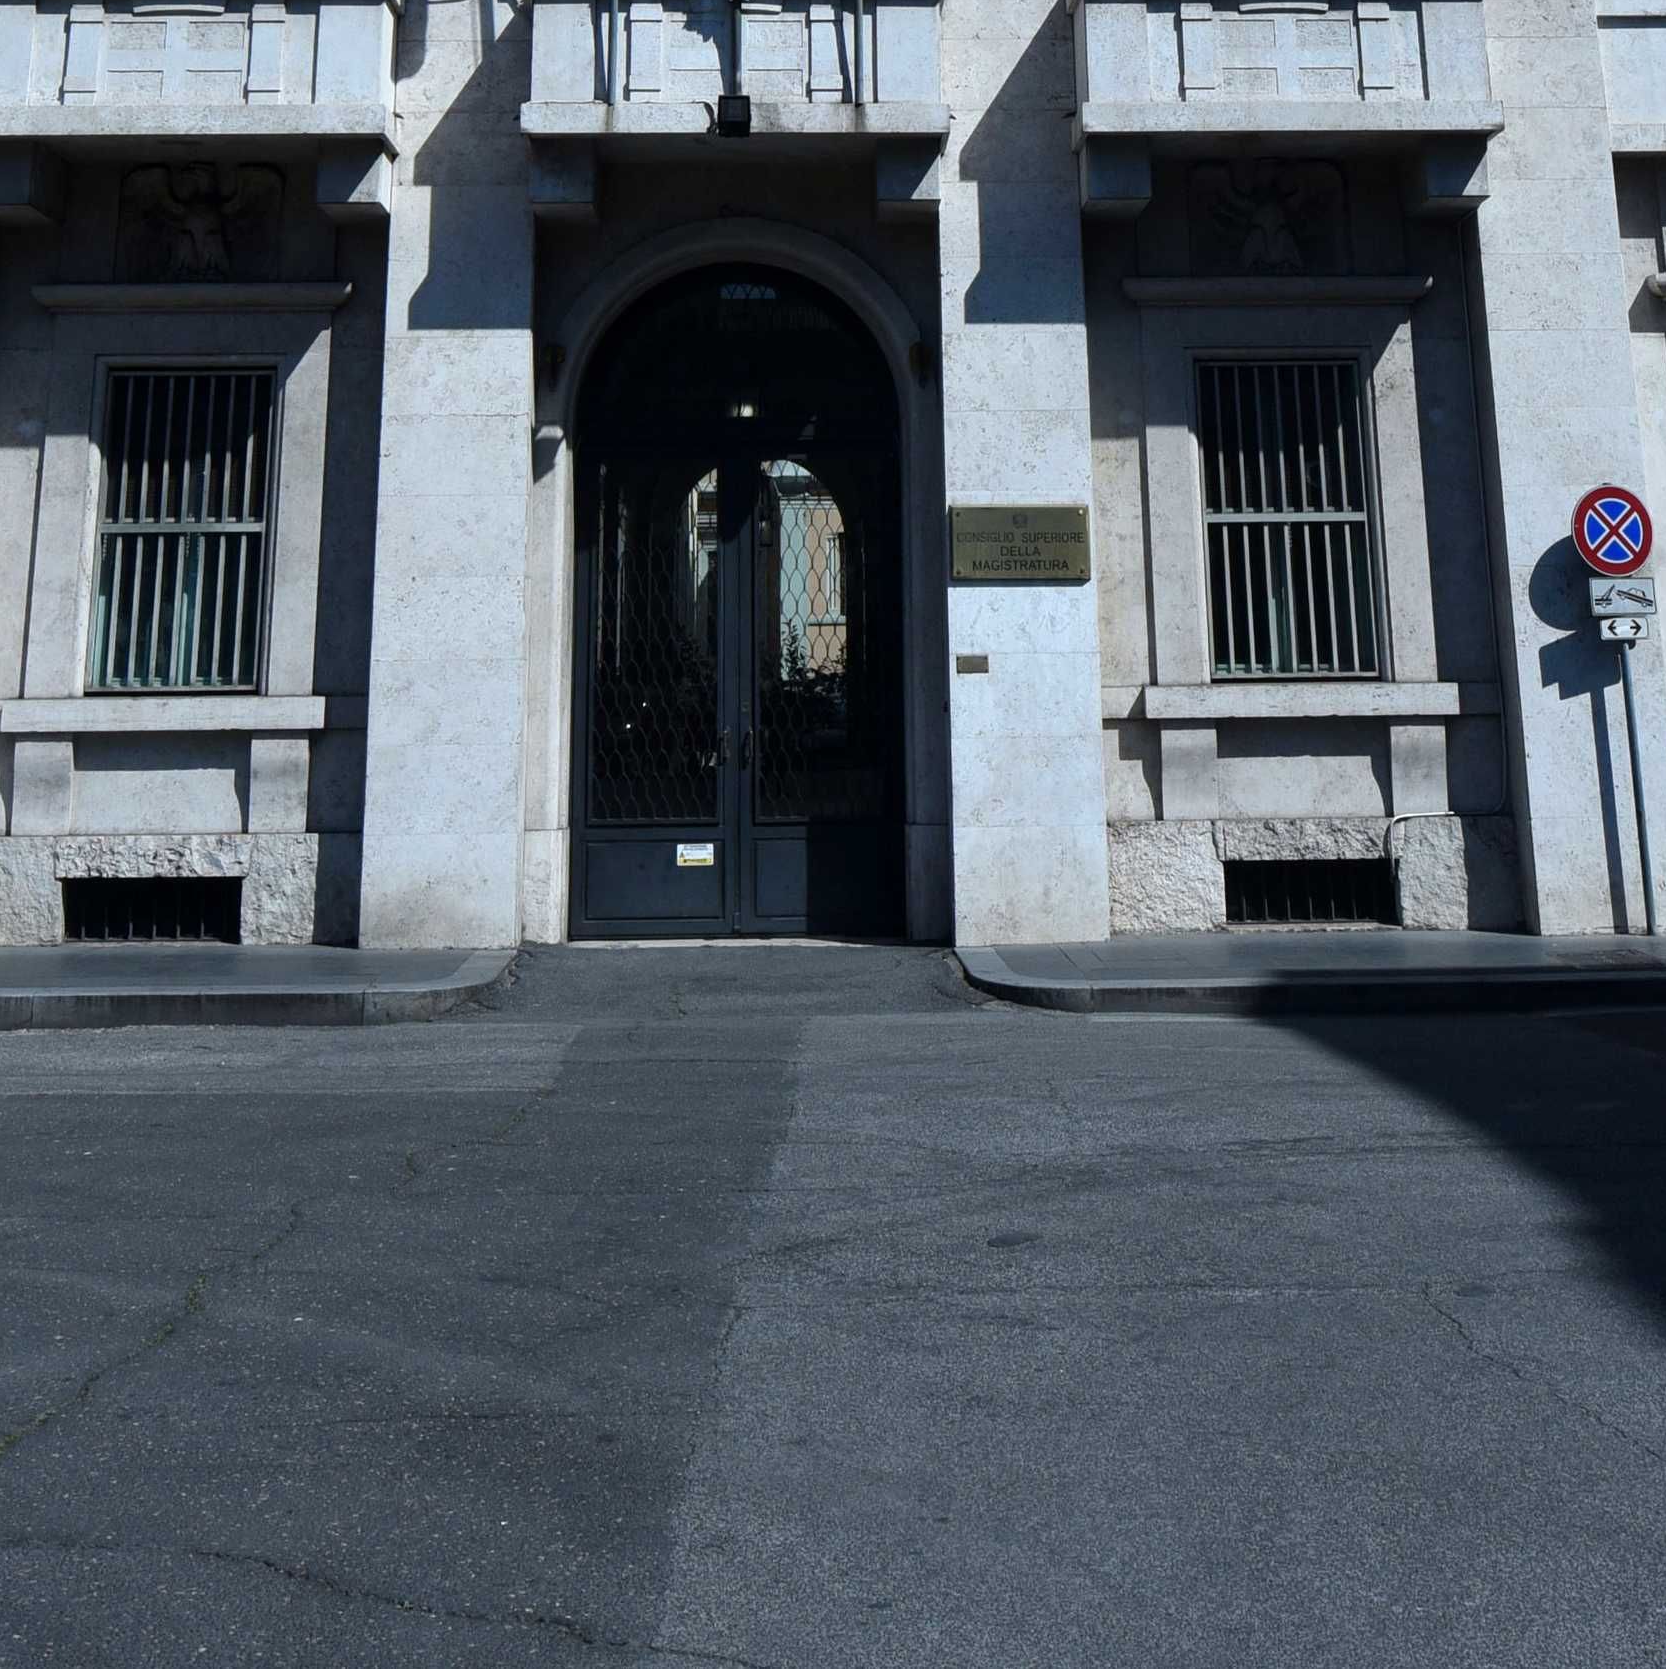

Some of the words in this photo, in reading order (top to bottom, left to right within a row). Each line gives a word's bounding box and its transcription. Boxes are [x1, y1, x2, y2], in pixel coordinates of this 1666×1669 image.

[956, 533, 1015, 543] CONSIGLIO
[1021, 533, 1085, 543] SUPERIORE
[1000, 546, 1041, 556] DELLA
[972, 560, 1069, 571] MAGISTRATURA
